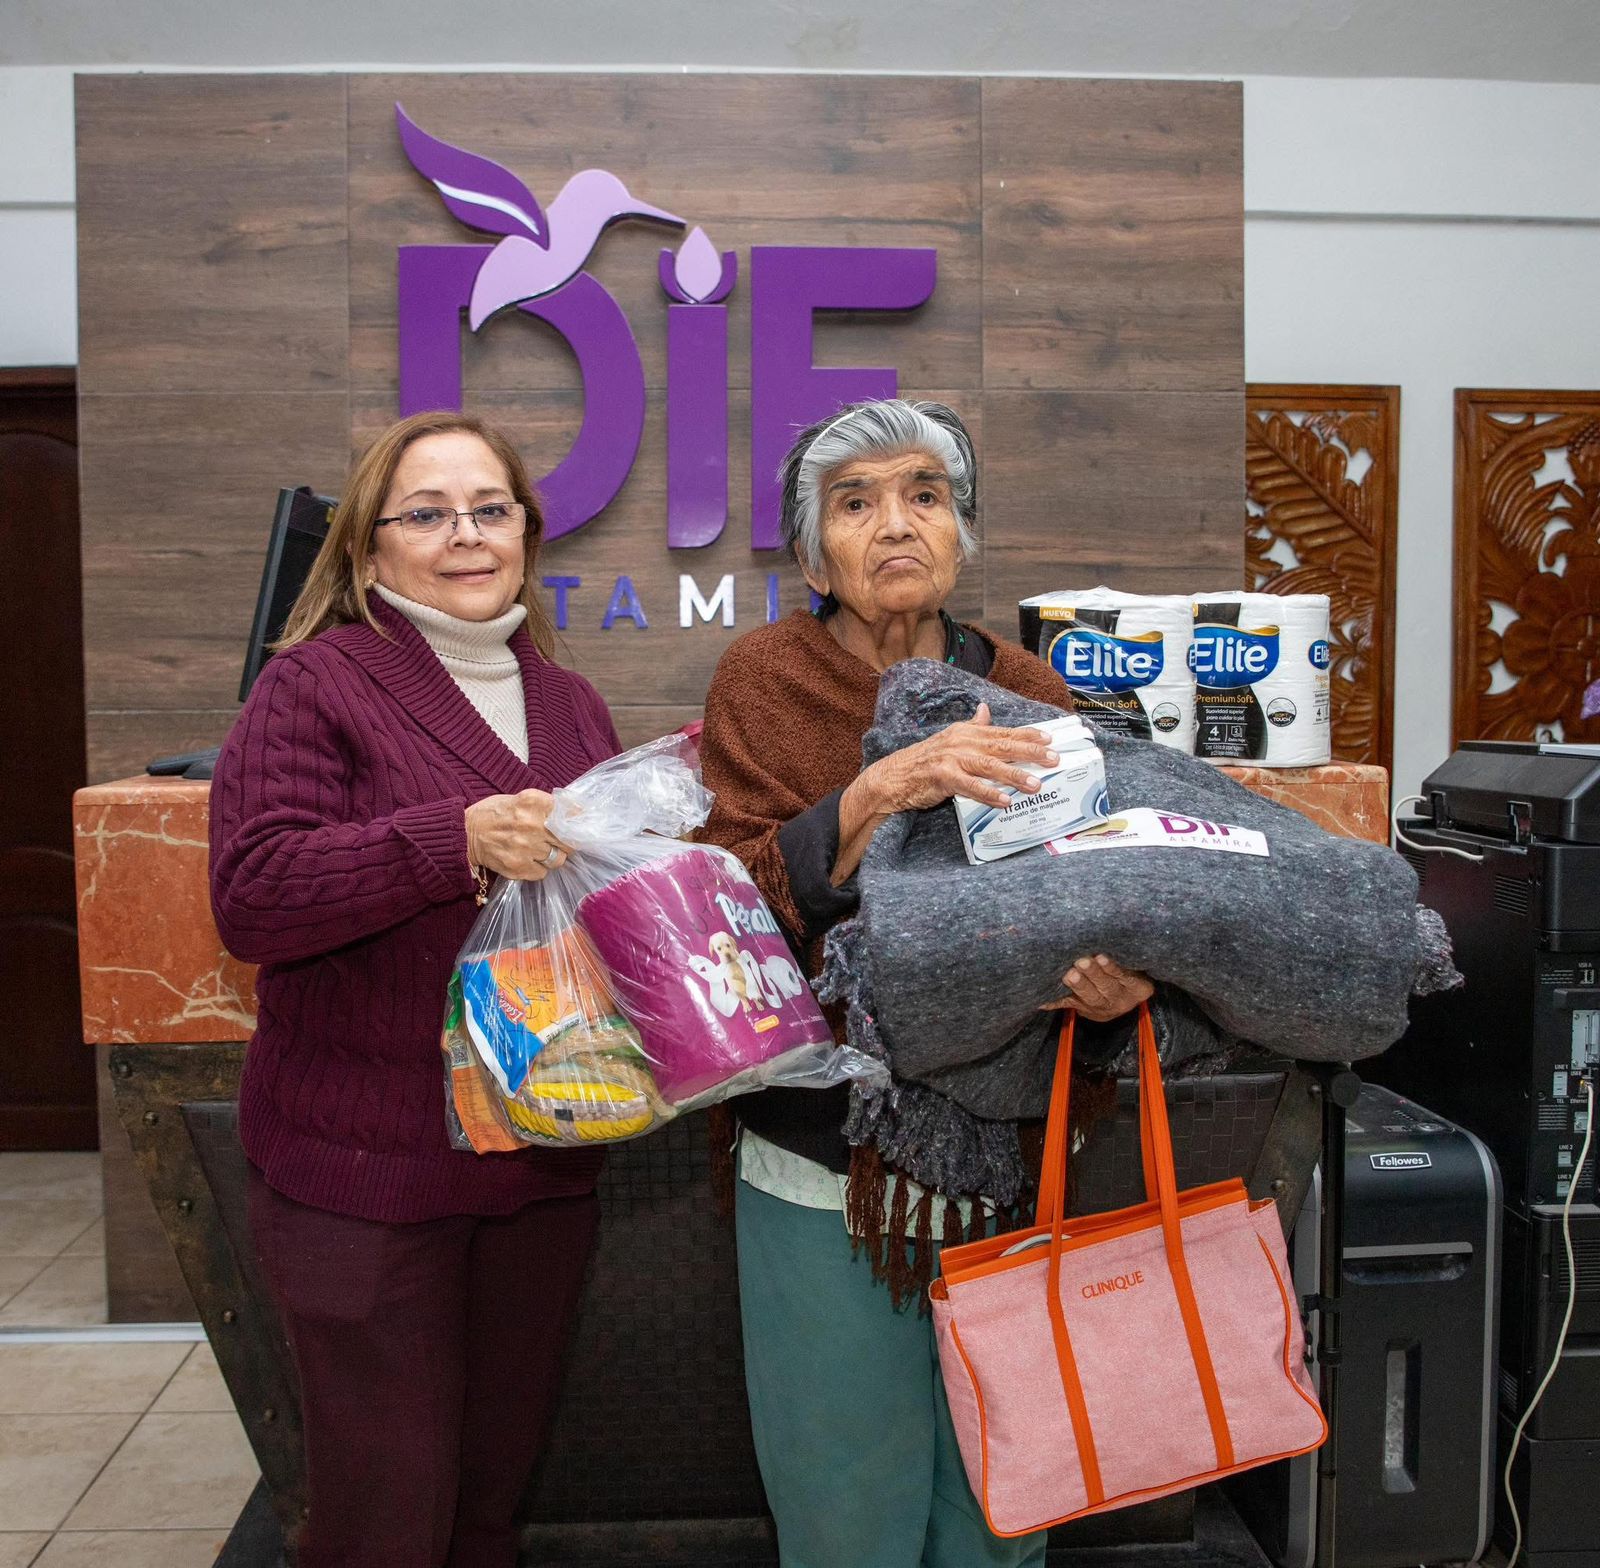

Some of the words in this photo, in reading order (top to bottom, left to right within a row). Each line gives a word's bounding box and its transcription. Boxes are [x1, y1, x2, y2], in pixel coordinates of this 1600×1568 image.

[1042, 610, 1072, 619] NUEVO
[1066, 640, 1152, 679] Elite
[1194, 636, 1268, 673] Elite
[1072, 697, 1116, 709] Premium
[1117, 699, 1138, 709] Soft
[1196, 694, 1236, 703] Premium
[1236, 694, 1254, 704] Soft
[1209, 725, 1220, 737] 4
[998, 809, 1029, 823] Valproato
[1030, 806, 1039, 814] de
[1039, 797, 1071, 811] magnesio
[1169, 836, 1253, 847] ALTAMIRA
[1380, 1156, 1424, 1167] Fellowes
[1081, 1270, 1145, 1299] CLINIQUE
